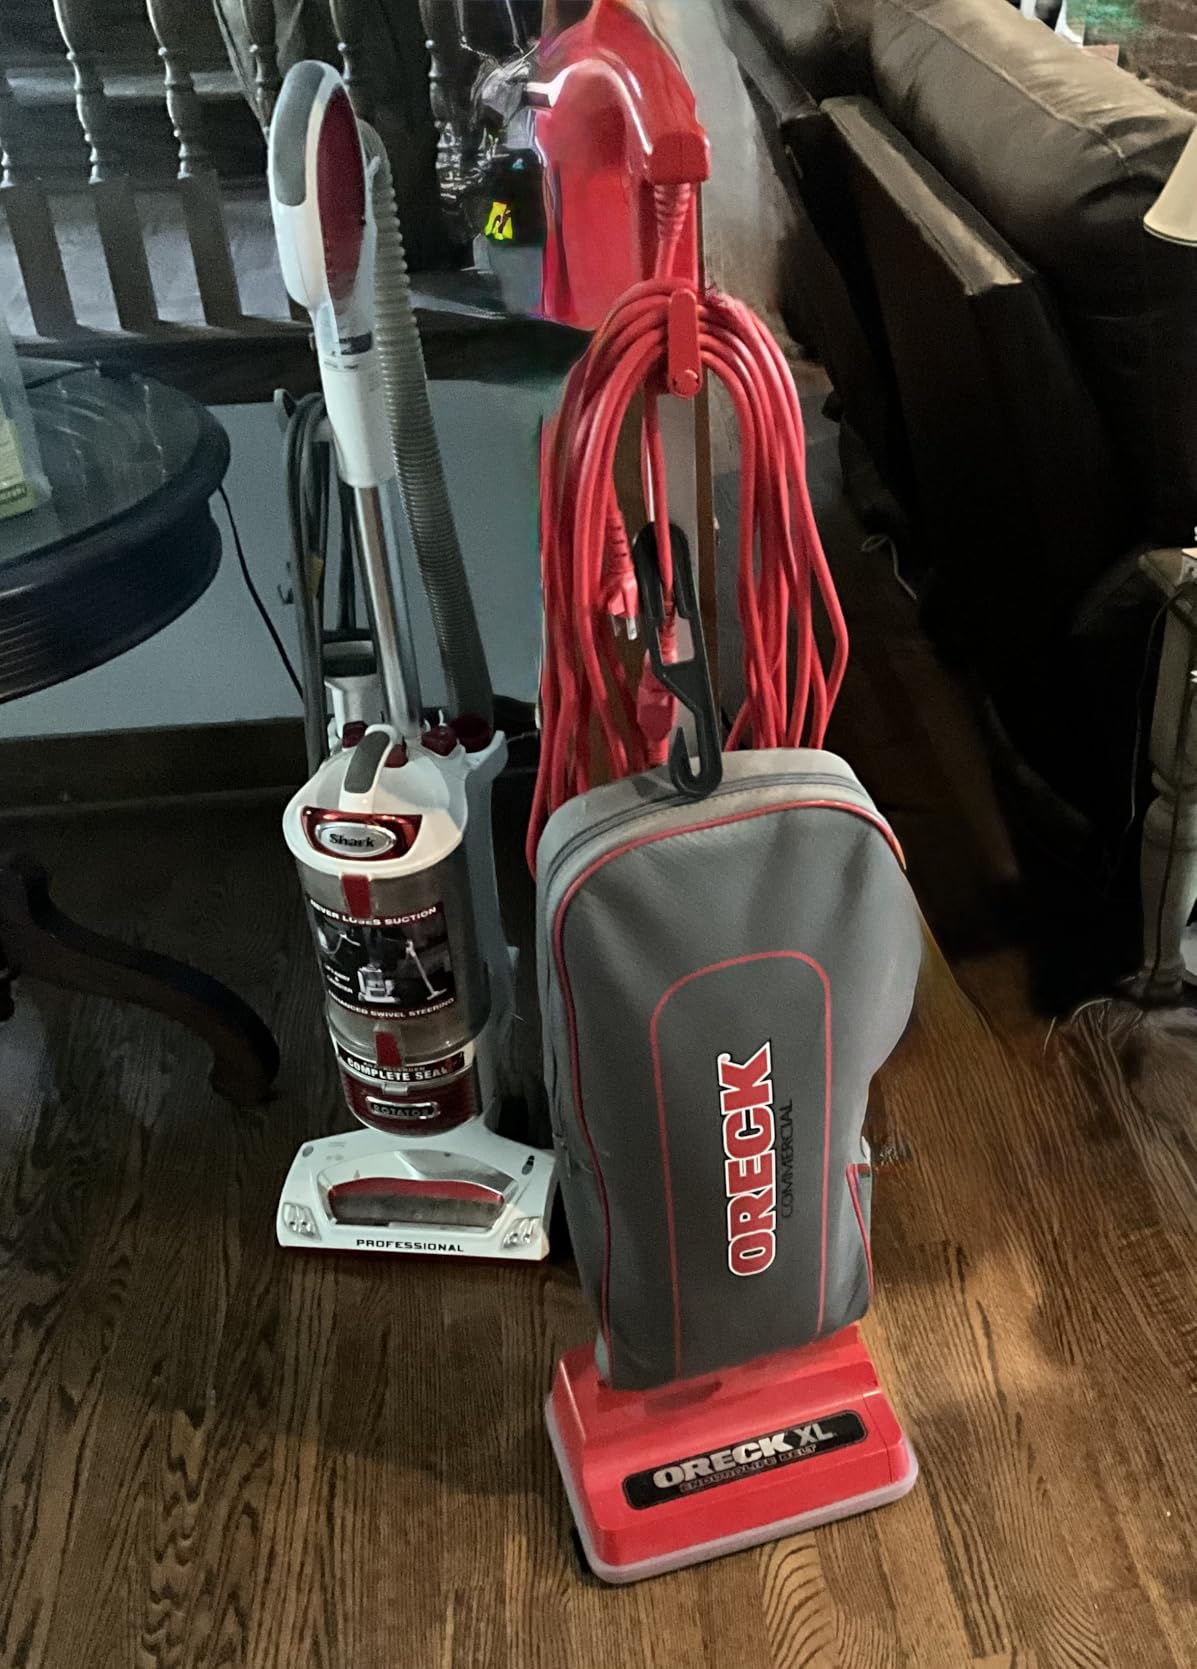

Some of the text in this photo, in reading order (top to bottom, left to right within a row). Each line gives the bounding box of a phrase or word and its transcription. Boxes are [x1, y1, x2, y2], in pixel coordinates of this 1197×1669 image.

[329, 833, 375, 848] Shark
[384, 906, 437, 926] SUCTION
[328, 989, 456, 1018] ANCED SWIVEL STEERING
[347, 1057, 411, 1081] COMPLETE
[415, 1066, 449, 1081] SEAL
[372, 1103, 430, 1117] ROTATOR
[717, 1041, 776, 1276] ORECK
[780, 1100, 793, 1218] COMMERCIAL
[356, 1239, 464, 1252] PROFESSIONAL
[653, 1423, 834, 1489] ORECK XL
